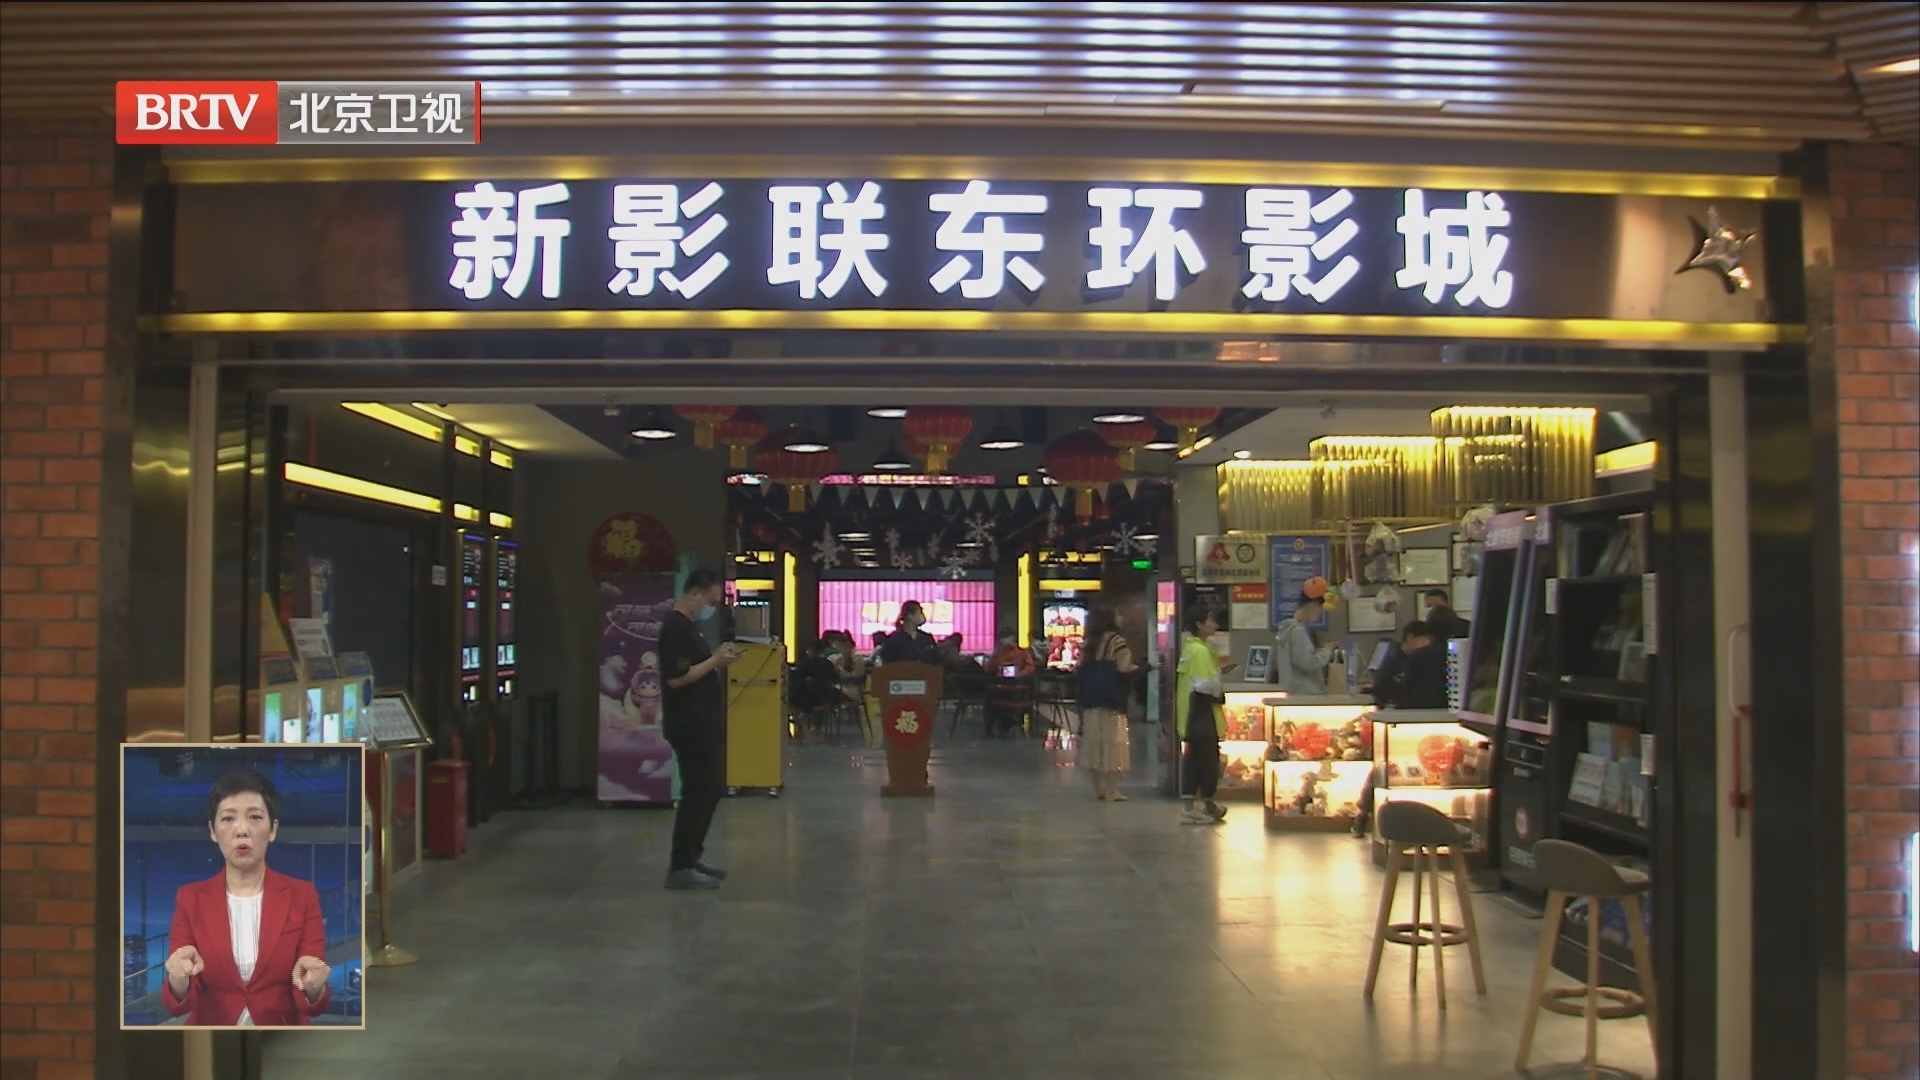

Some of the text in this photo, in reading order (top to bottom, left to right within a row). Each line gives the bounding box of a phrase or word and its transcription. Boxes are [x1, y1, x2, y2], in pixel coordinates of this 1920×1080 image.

[449, 180, 1514, 309] 新影联东环影城
[895, 710, 919, 734] 福
